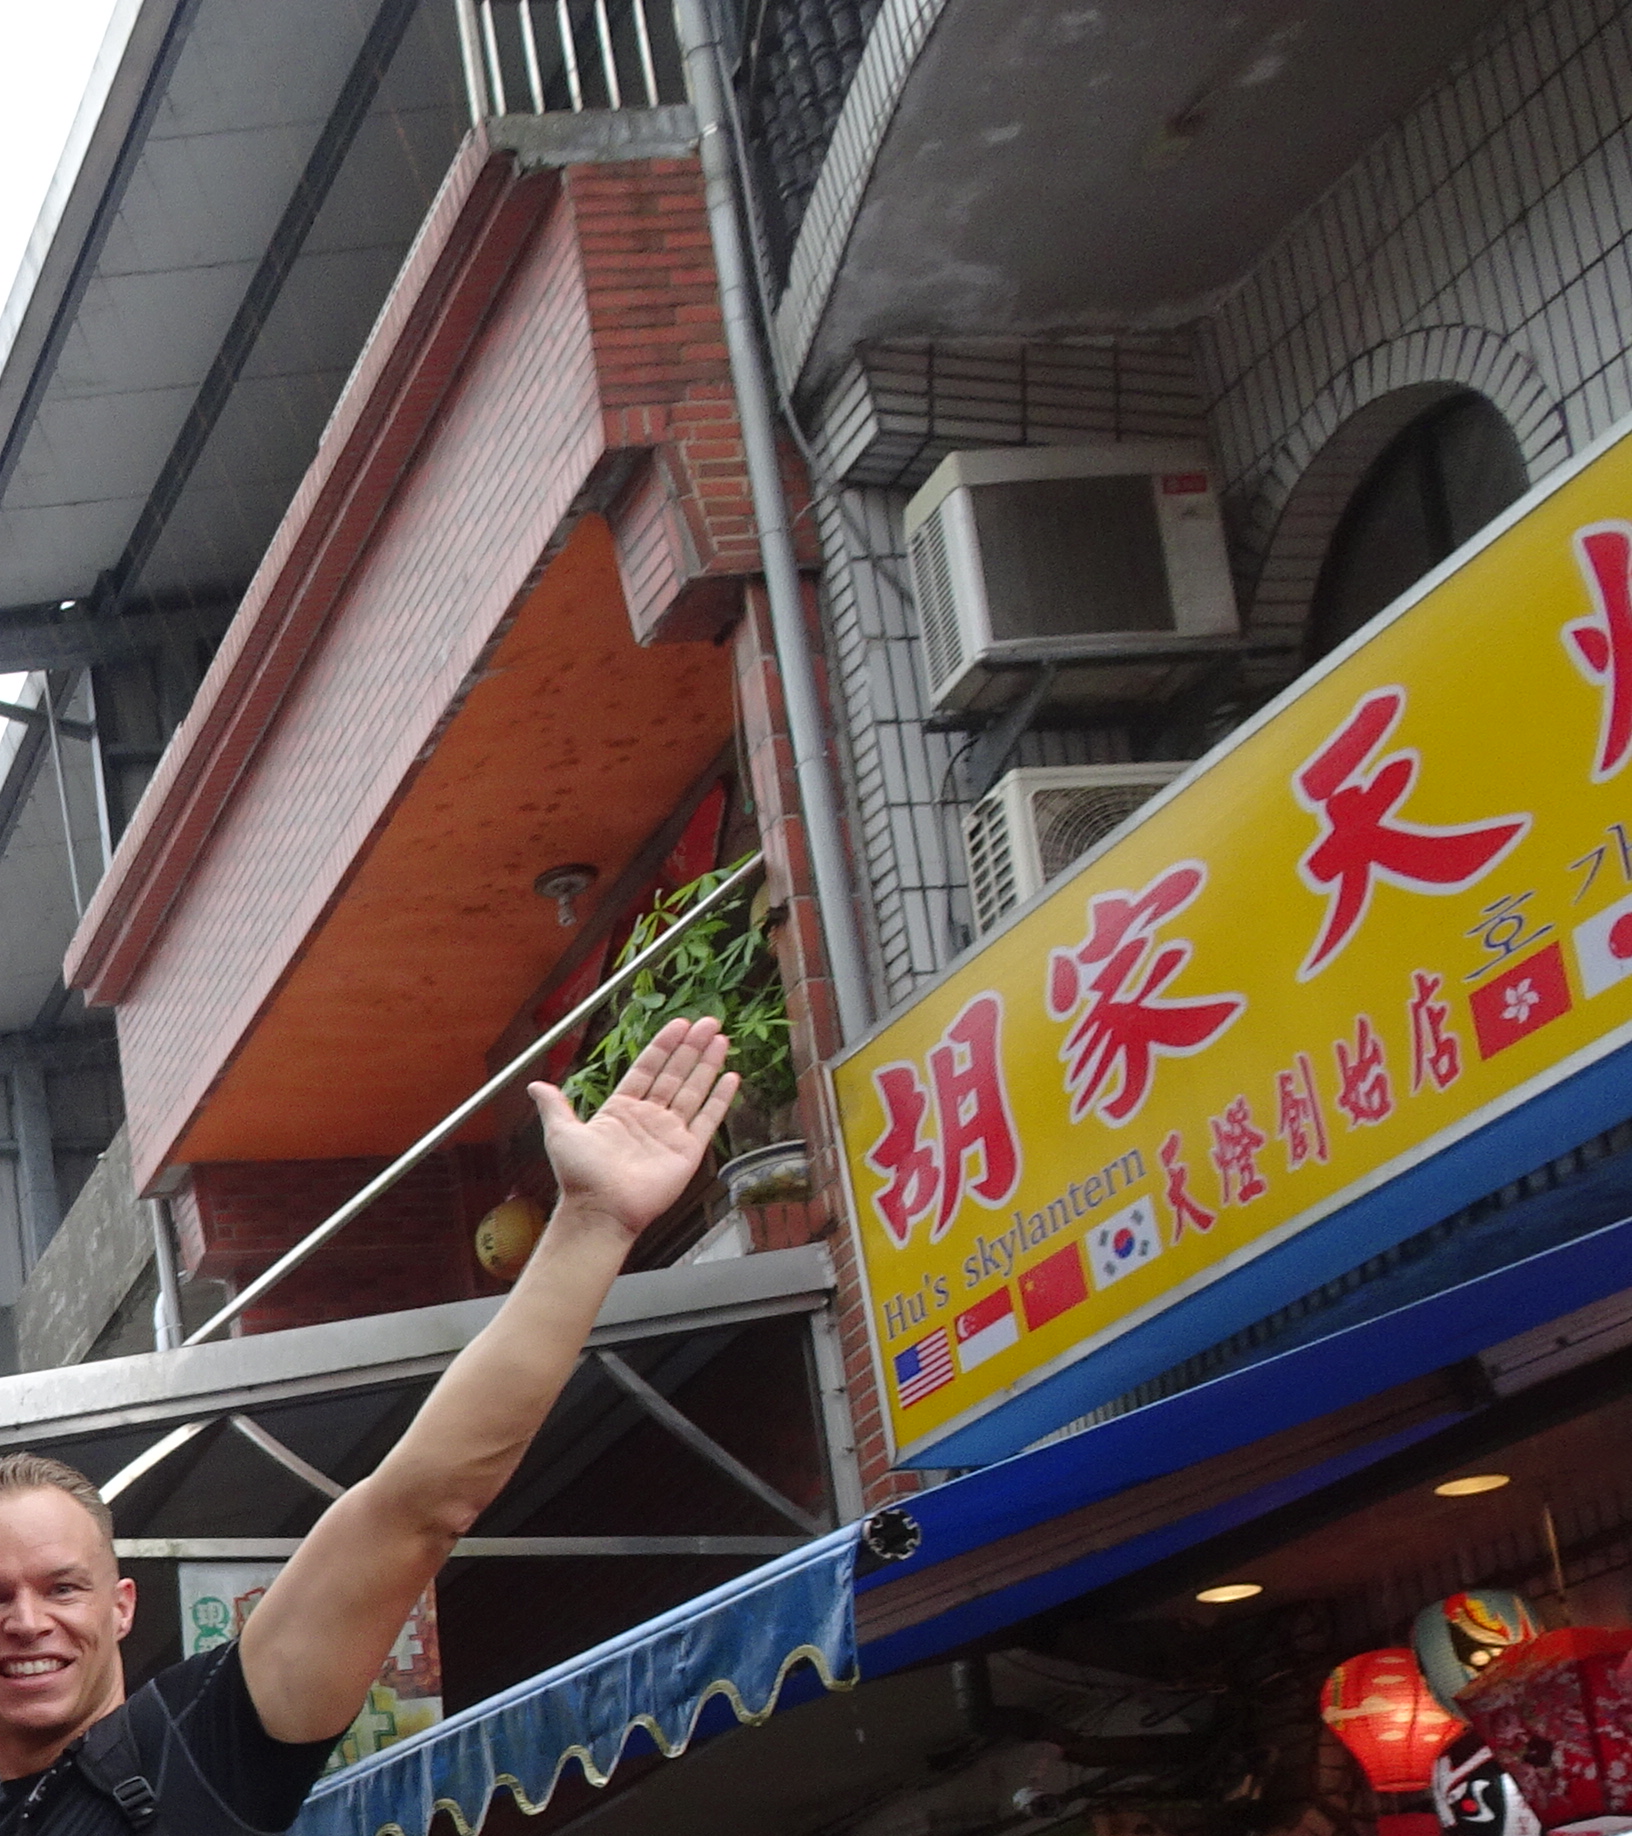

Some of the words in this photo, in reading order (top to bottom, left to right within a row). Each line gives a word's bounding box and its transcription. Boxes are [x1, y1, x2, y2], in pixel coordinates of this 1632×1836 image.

[1159, 969, 1461, 1242] 天燈創始店
[882, 1268, 951, 1342] Hu's
[964, 1145, 1149, 1290] skylantern
